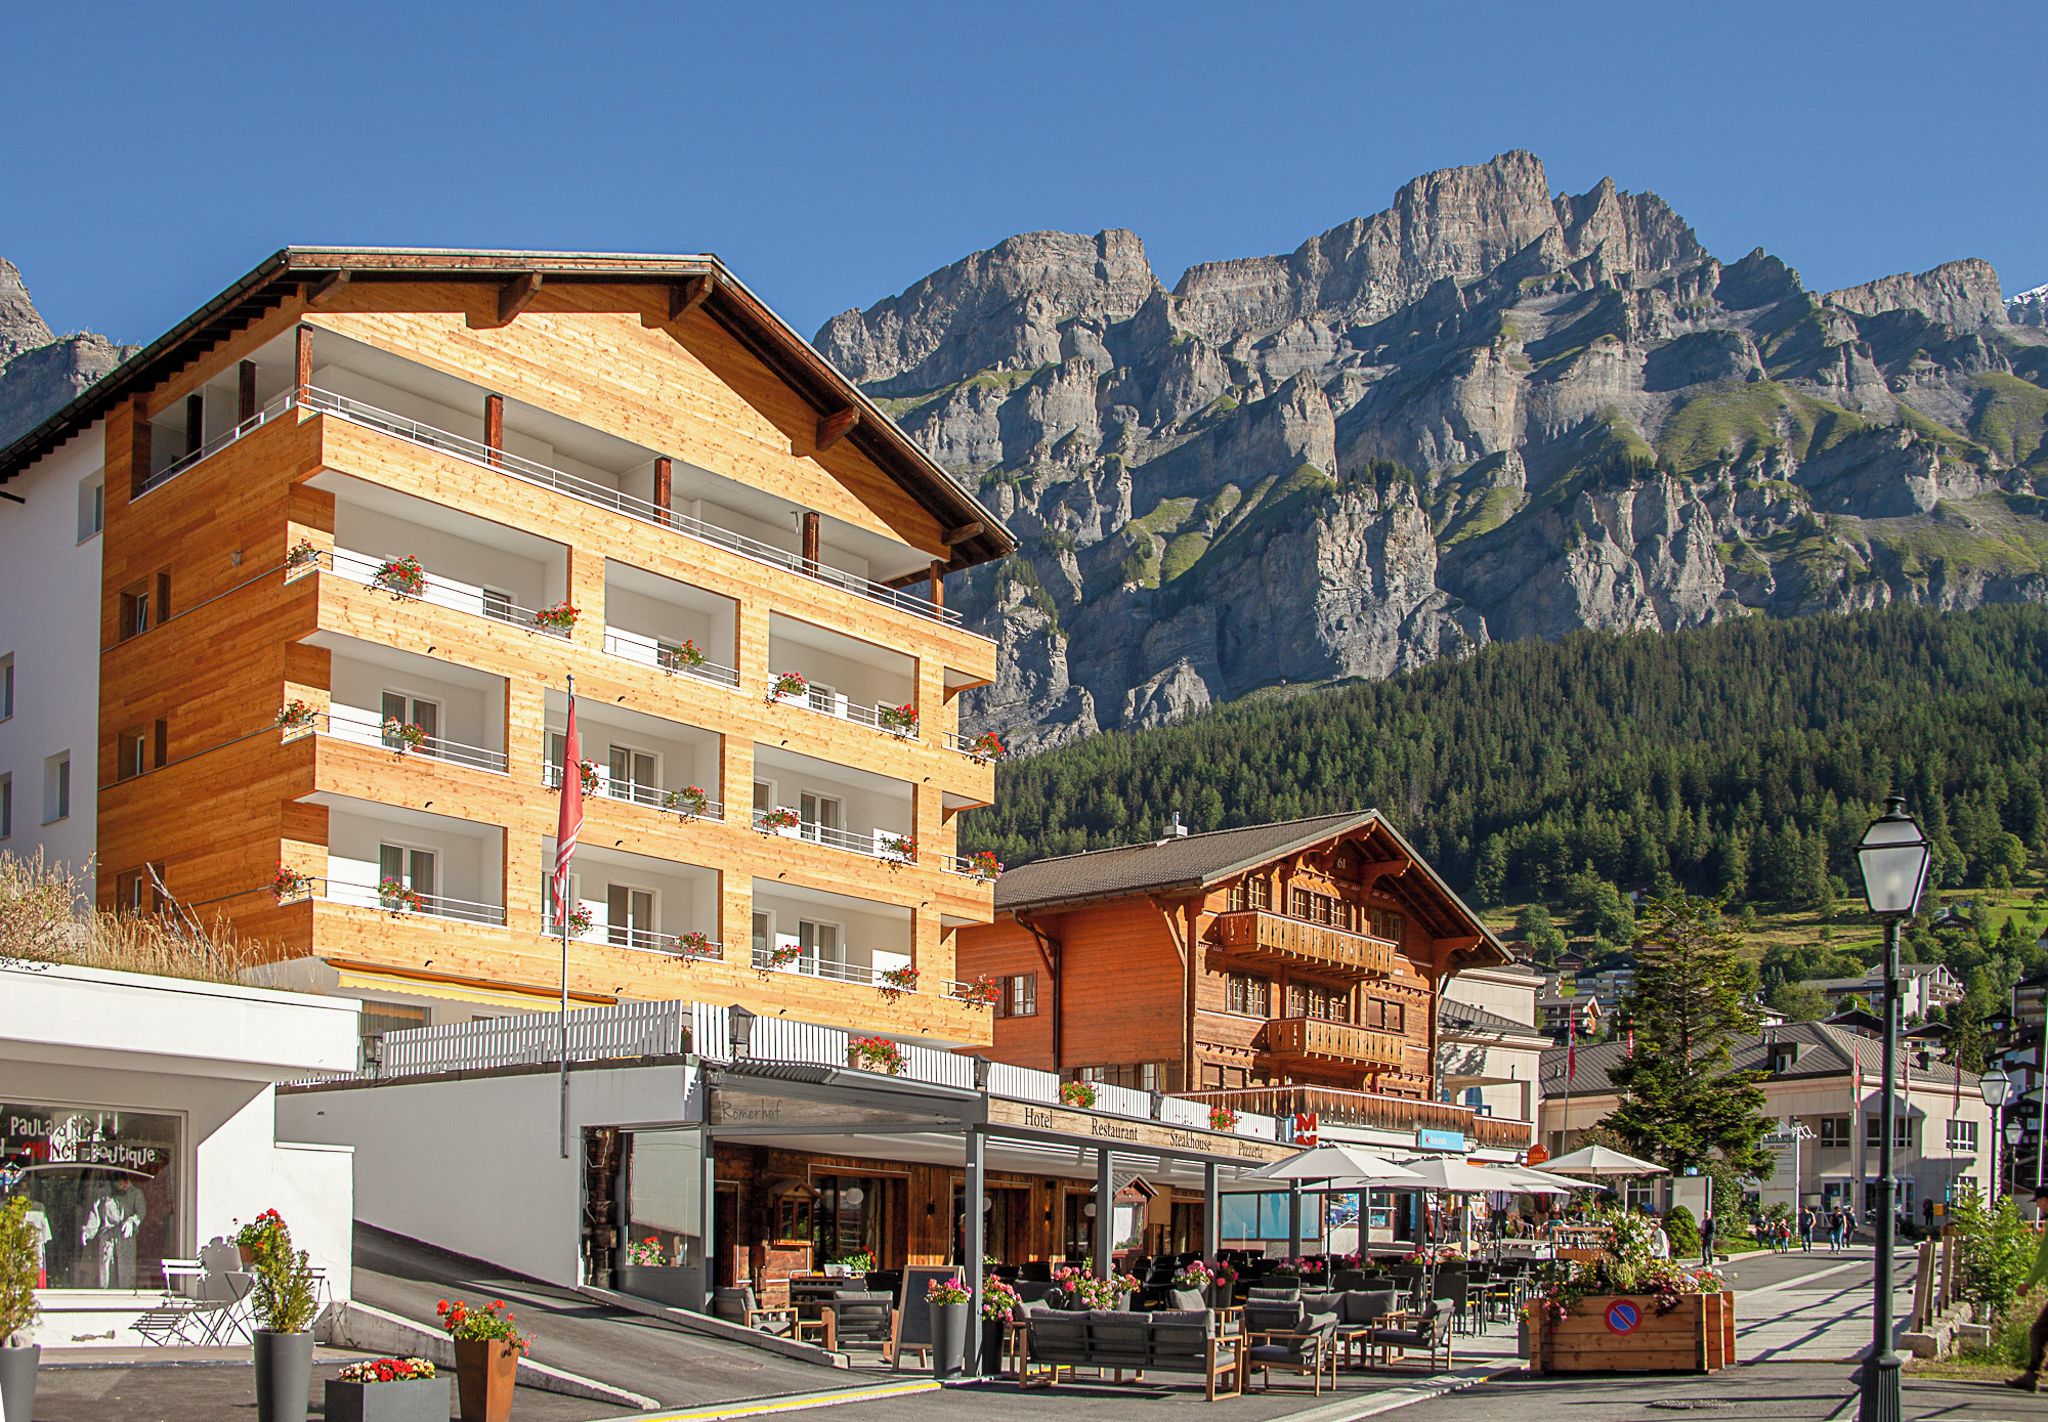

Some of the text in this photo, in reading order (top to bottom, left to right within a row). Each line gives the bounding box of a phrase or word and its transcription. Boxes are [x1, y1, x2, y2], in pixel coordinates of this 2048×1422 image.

[1024, 1107, 1264, 1159] Hotel Restaurant Steakhouse Pizzeria
